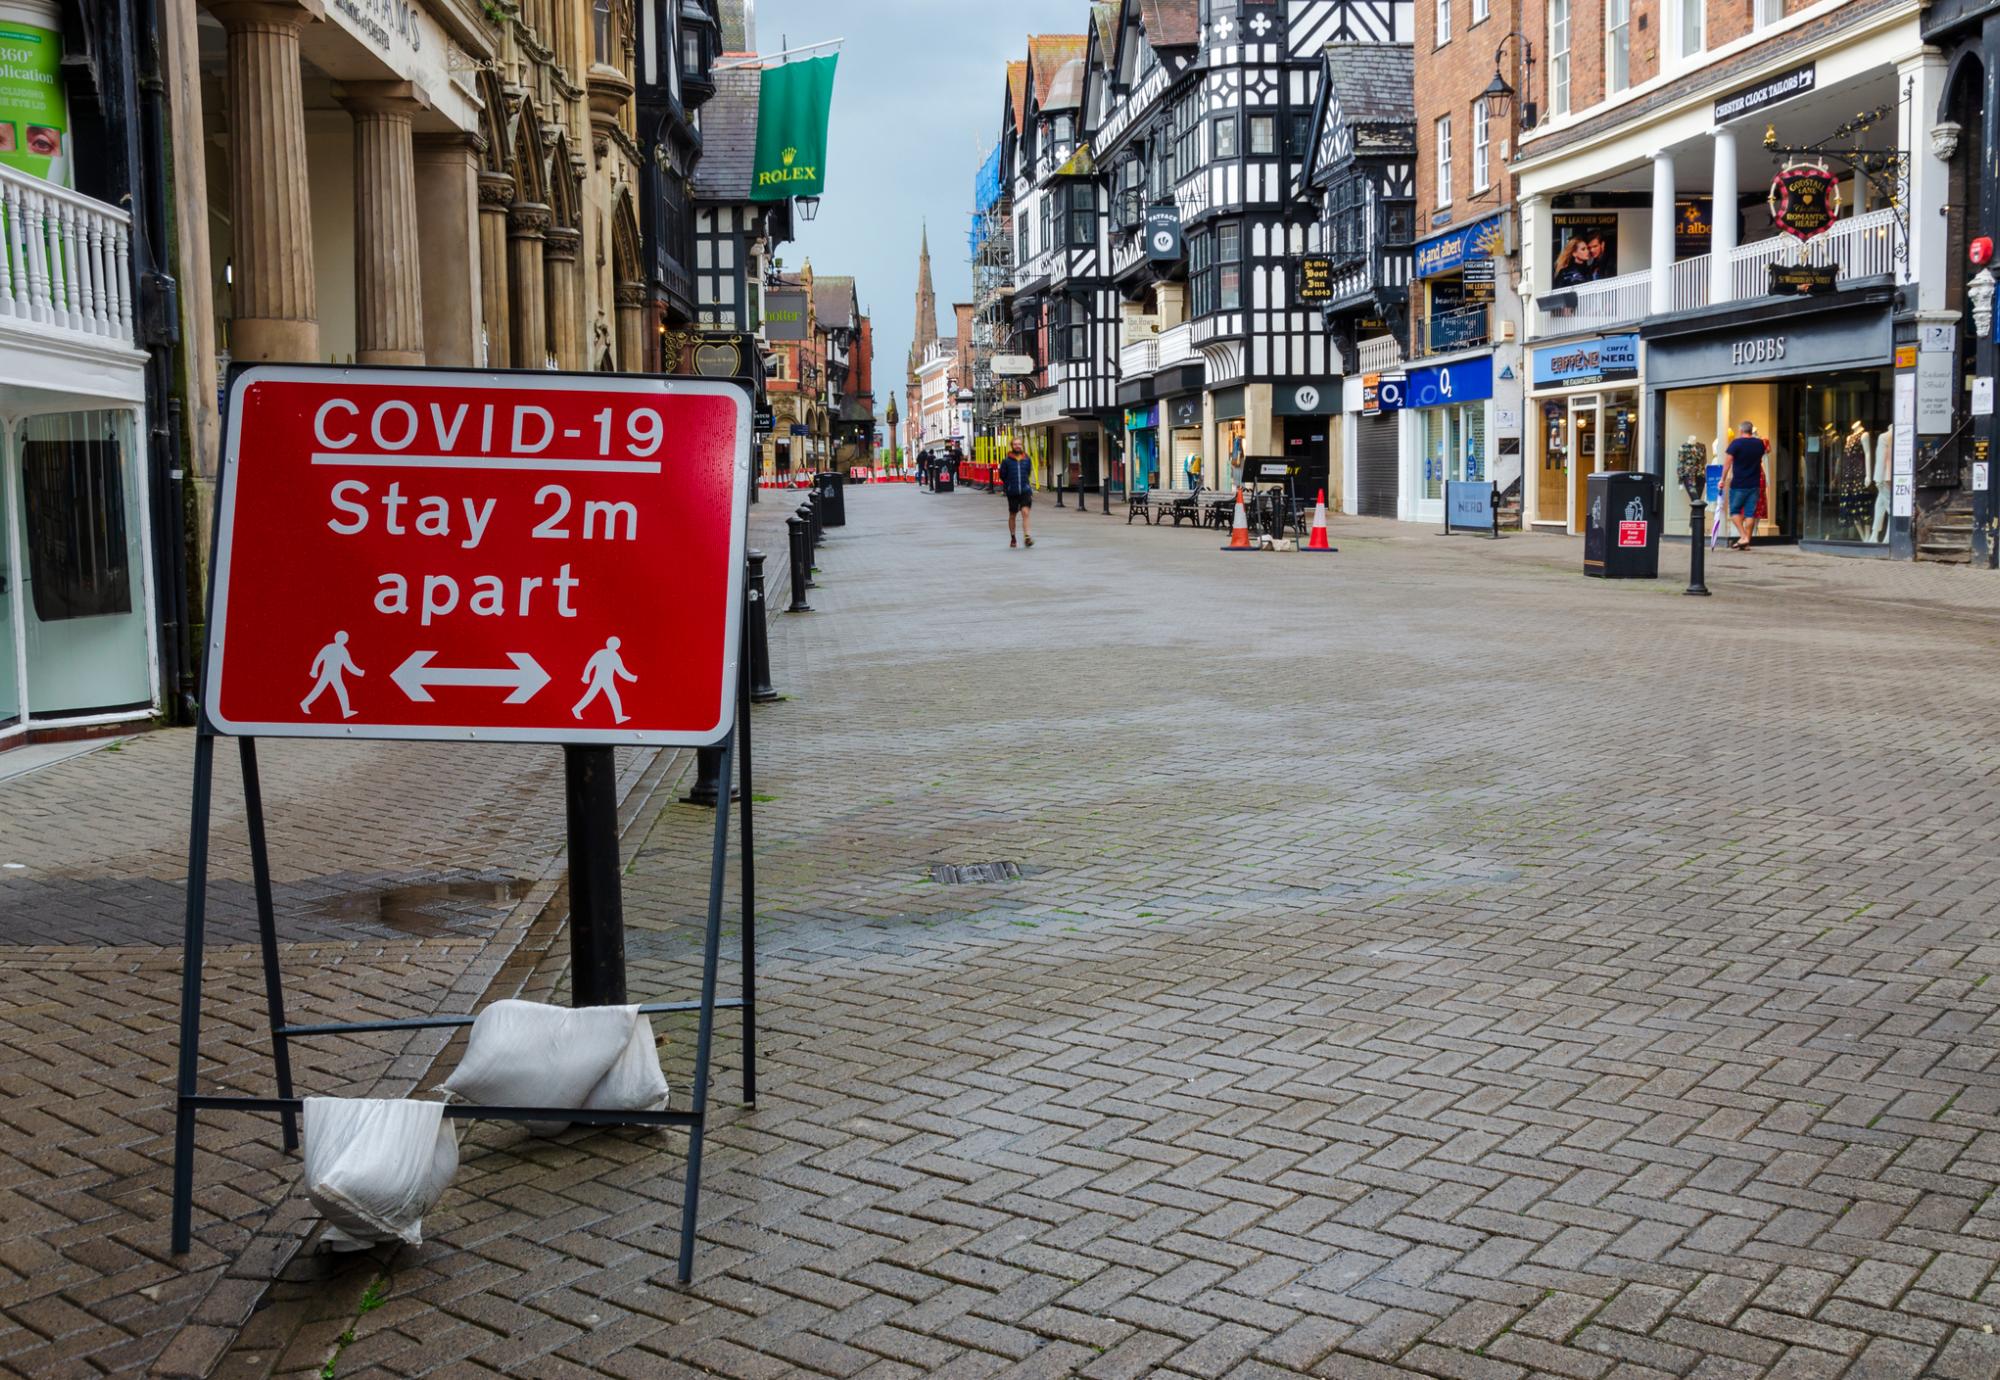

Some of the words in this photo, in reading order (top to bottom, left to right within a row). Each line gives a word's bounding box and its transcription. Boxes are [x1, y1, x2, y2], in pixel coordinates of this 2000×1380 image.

[1715, 97, 1744, 118] CHESTER
[1745, 87, 1768, 107] CLOCK
[1768, 76, 1798, 98] TAILORS
[759, 166, 816, 185] ROLEX
[1148, 213, 1178, 222] FATFACE
[1554, 216, 1567, 225] THE
[1568, 216, 1596, 225] LEATHER
[1598, 216, 1616, 225] SHOP
[1786, 212, 1828, 221] ROMANTIC
[1794, 220, 1819, 228] HEART
[1426, 243, 1440, 263] and
[1441, 236, 1461, 258] albert
[1305, 269, 1328, 279] Boot
[1307, 279, 1326, 288] Inn
[1732, 336, 1785, 364] HOBBS
[1601, 353, 1635, 363] NERO
[313, 398, 664, 458] COVID-19
[1895, 484, 1910, 496] ZEN
[1458, 501, 1483, 513] NERO
[326, 479, 497, 549] Stay
[531, 484, 638, 541] 2m
[374, 563, 580, 627] apart
